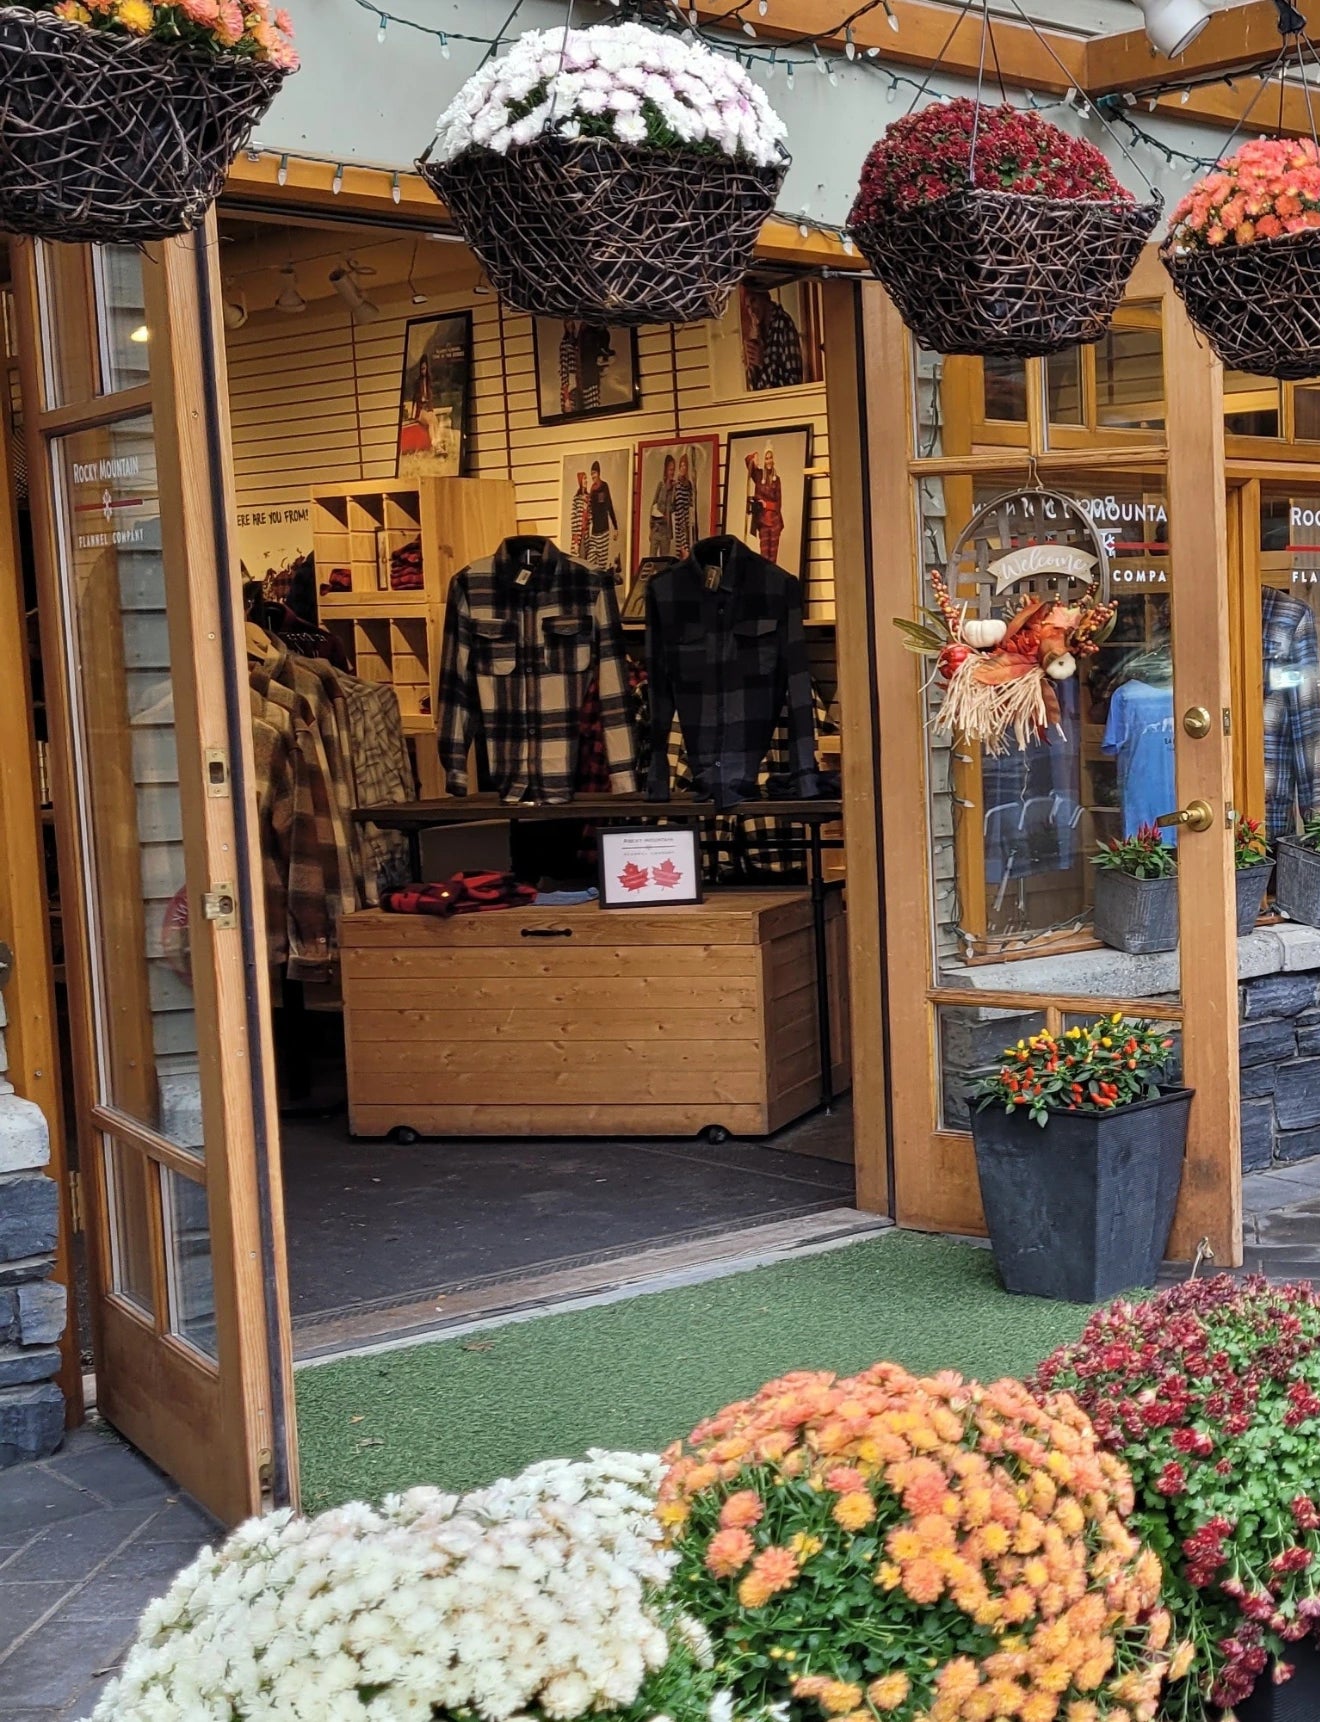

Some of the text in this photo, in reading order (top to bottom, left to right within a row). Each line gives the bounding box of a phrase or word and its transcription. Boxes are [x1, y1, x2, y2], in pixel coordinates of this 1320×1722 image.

[73, 456, 139, 484] ROCKY MOUNTAIN
[237, 514, 251, 528] ERE
[252, 512, 267, 526] ARE
[268, 510, 282, 525] YOU
[1090, 502, 1168, 522] MOUNTA
[78, 528, 144, 549] FLANNEL COMPANY
[1001, 547, 1088, 581] Welcome
[1112, 569, 1167, 583] COMPA
